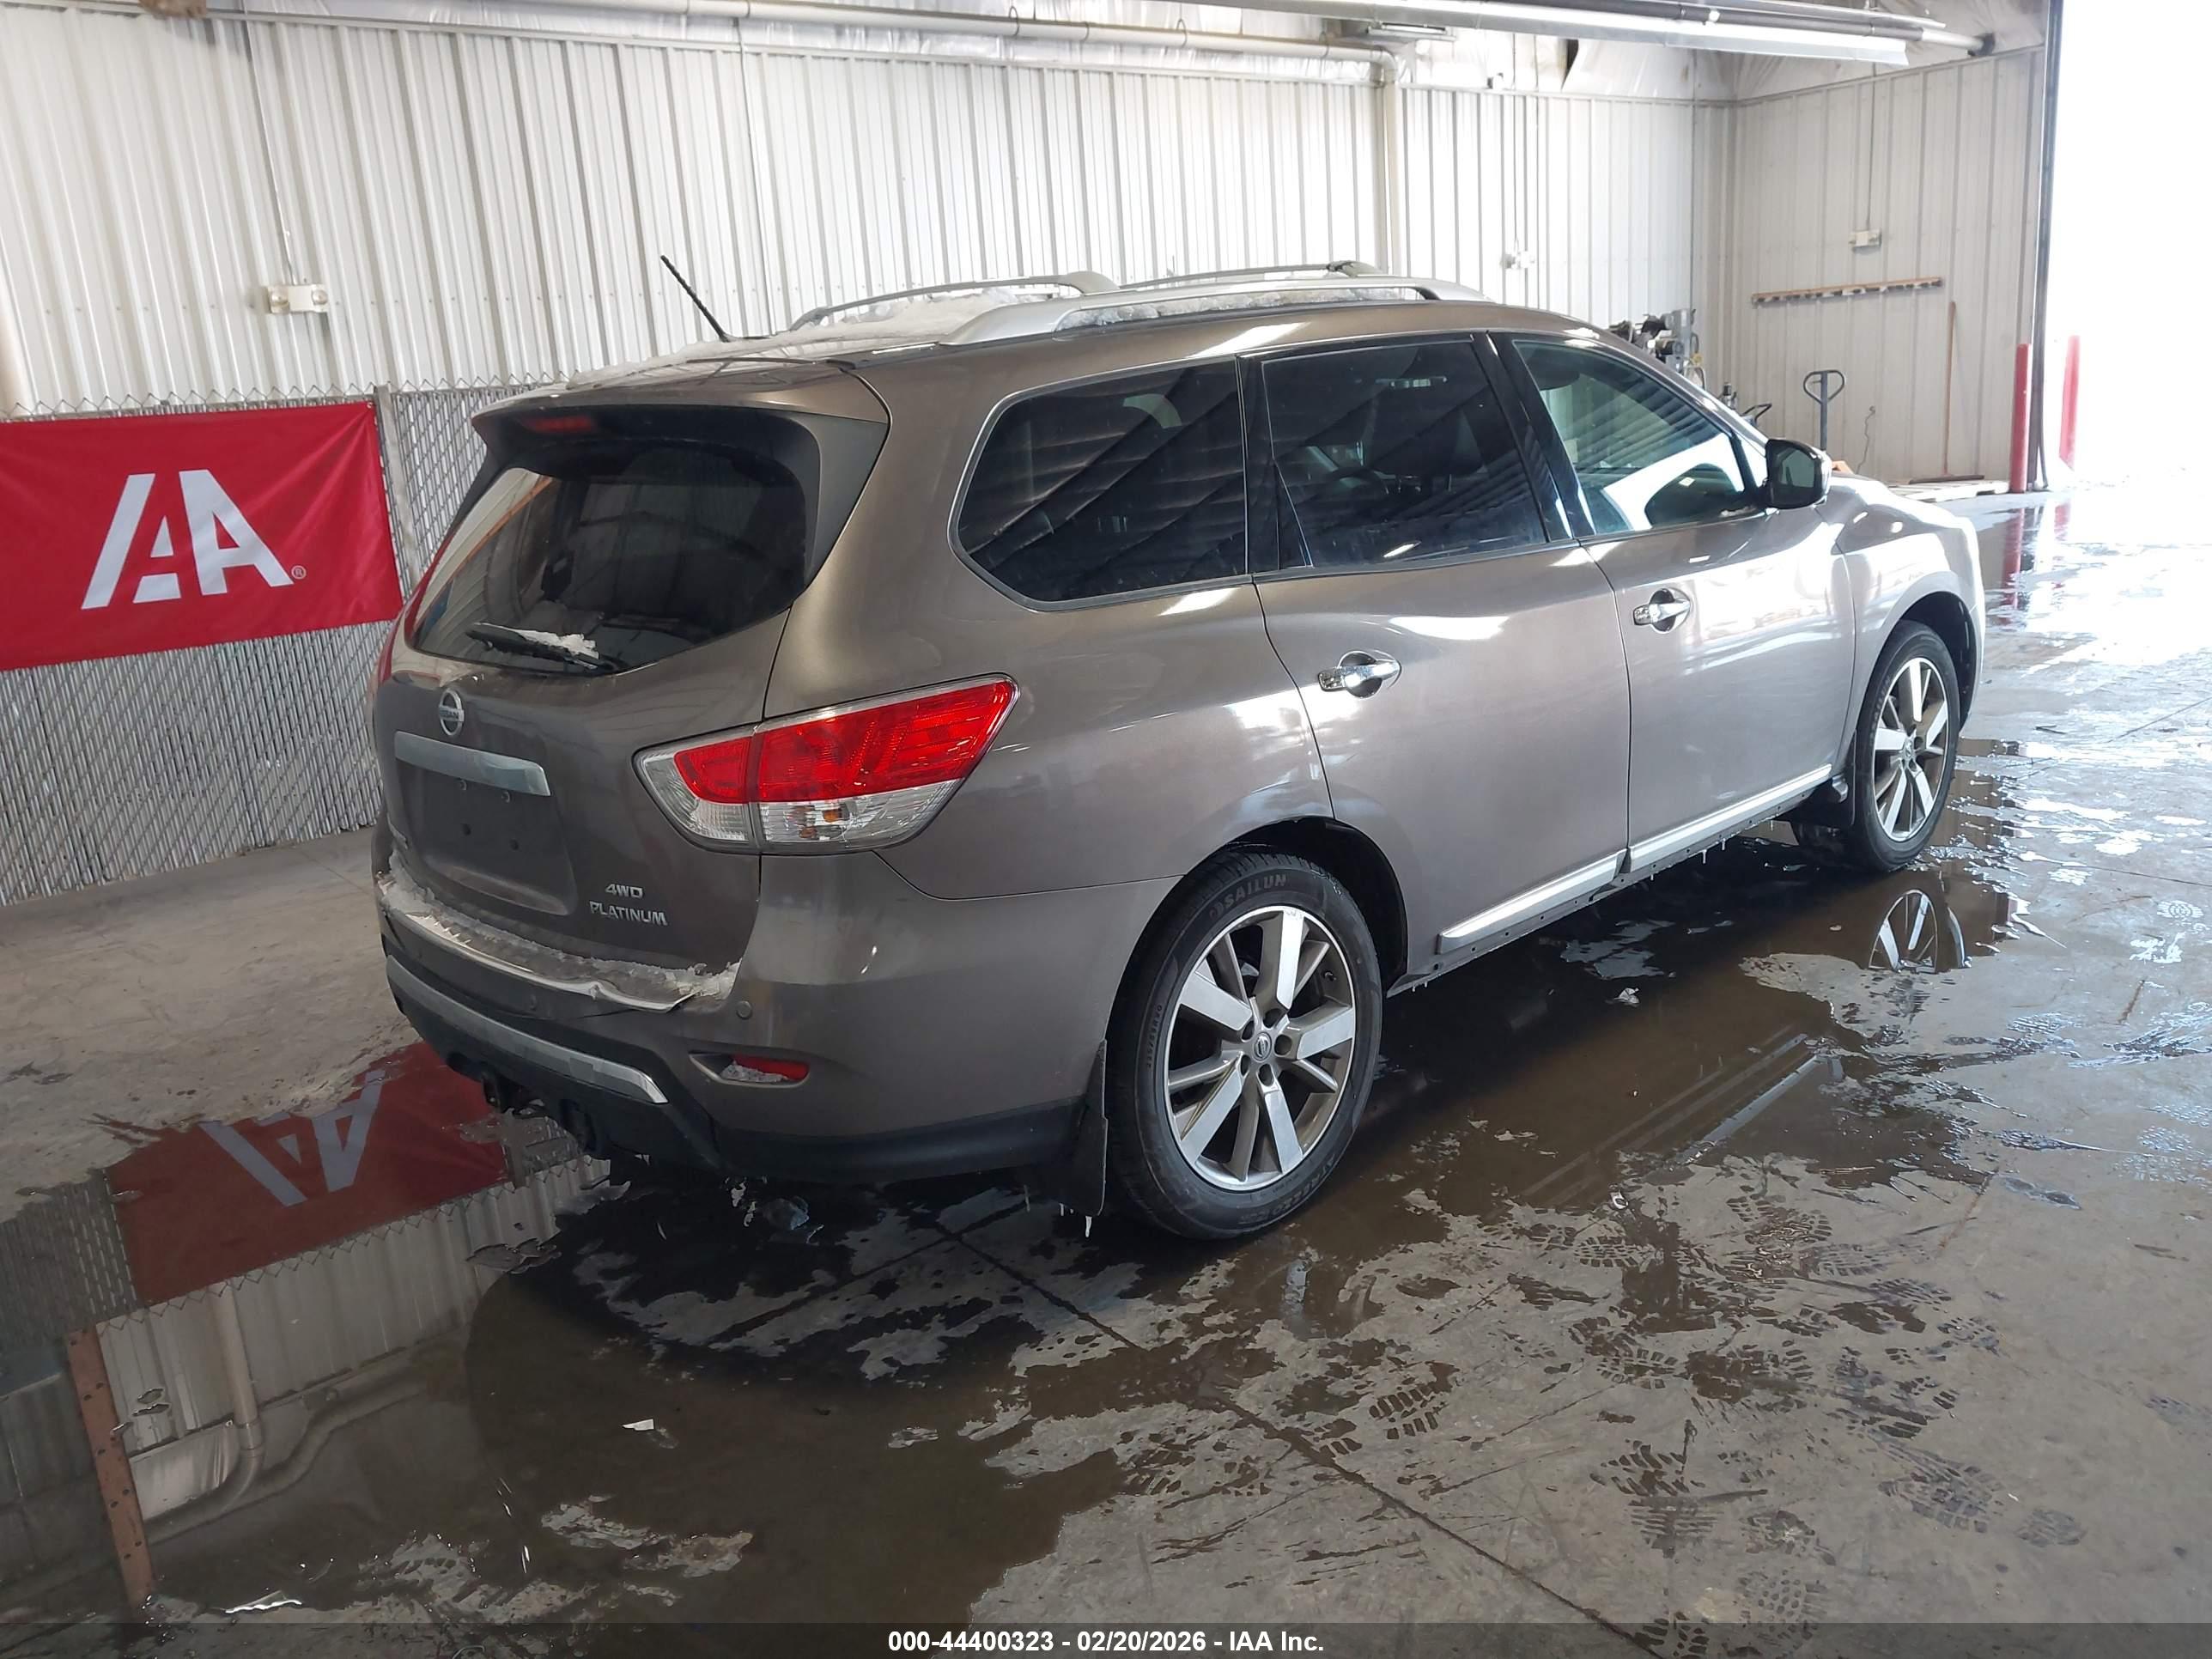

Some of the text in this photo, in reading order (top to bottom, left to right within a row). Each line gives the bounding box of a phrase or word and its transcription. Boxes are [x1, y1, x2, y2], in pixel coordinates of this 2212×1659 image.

[605, 884, 643, 899] 4WD
[1224, 874, 1286, 908] SAILUN
[589, 901, 668, 926] PLATINUM
